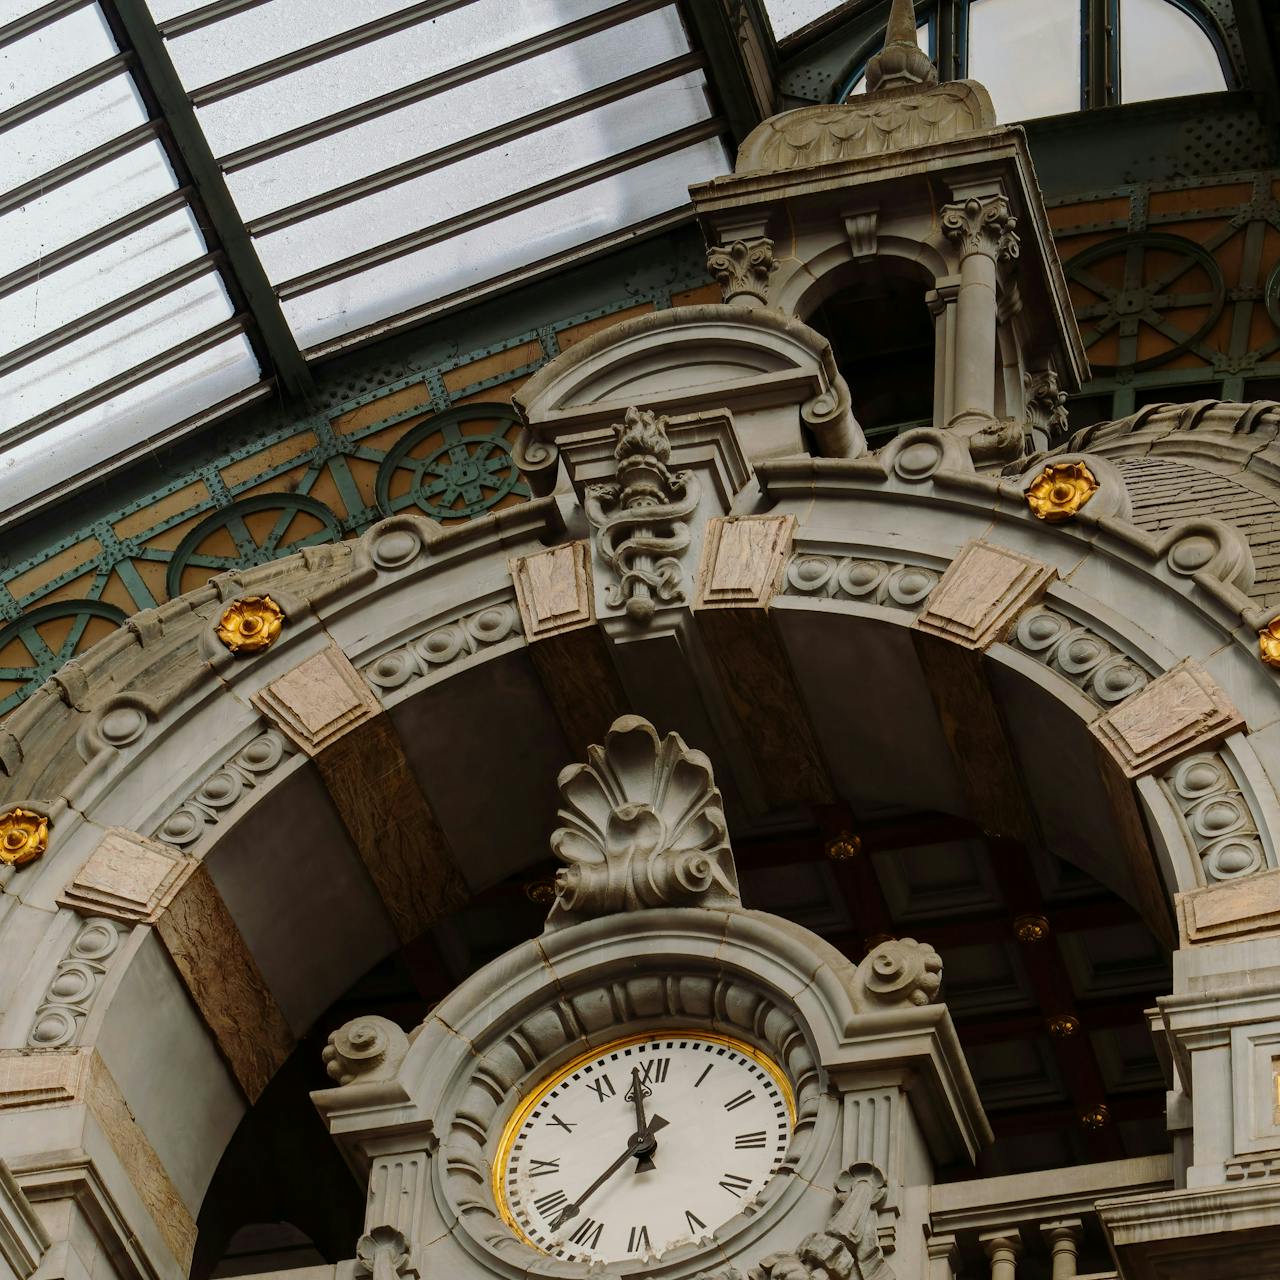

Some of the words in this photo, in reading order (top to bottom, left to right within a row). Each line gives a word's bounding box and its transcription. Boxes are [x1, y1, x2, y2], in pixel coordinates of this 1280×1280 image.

[640, 1058, 670, 1084] XII
[694, 1064, 714, 1087] I
[586, 1074, 616, 1102] XI
[724, 1090, 755, 1111] II
[546, 1114, 577, 1133] X
[735, 1131, 766, 1149] III
[529, 1158, 560, 1178] IX
[719, 1174, 752, 1198] IV
[568, 1217, 604, 1249] VII
[685, 1210, 707, 1234] V
